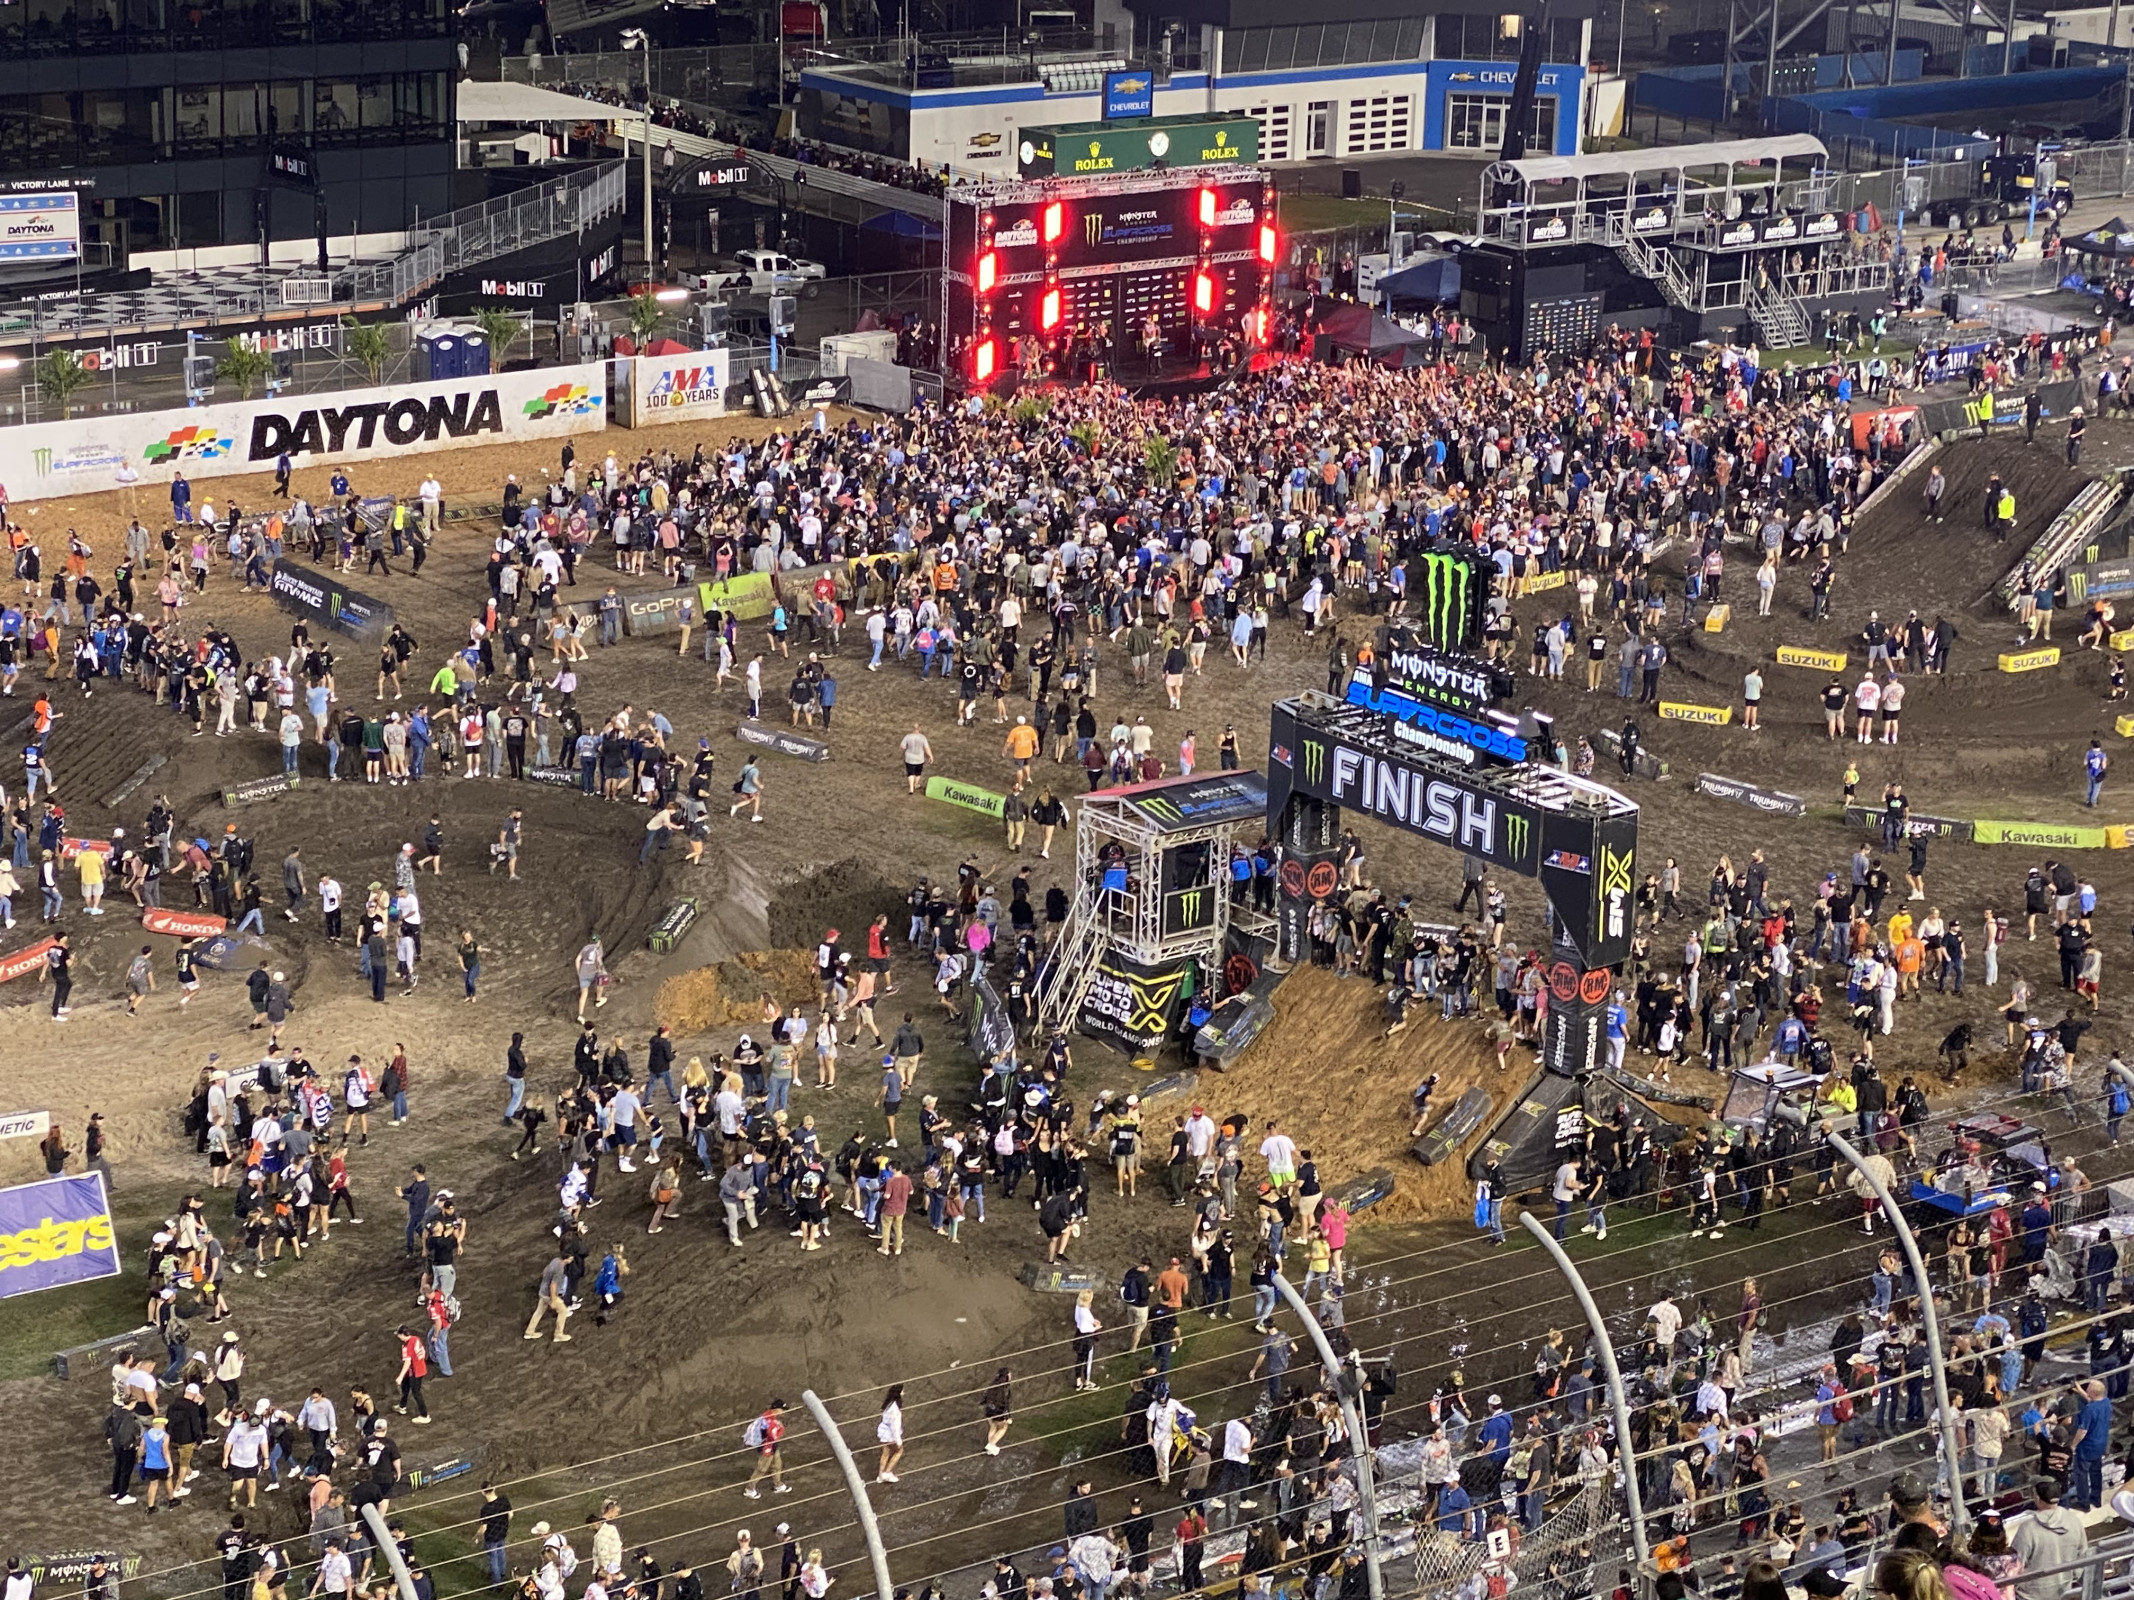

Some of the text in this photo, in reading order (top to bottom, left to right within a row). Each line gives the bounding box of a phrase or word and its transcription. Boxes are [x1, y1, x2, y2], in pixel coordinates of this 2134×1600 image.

[1480, 71, 1558, 85] CHEVET
[1109, 101, 1150, 113] CHEVROLET
[967, 151, 1002, 159] CHEVROLET
[1037, 150, 1053, 158] ROLEX
[1202, 147, 1238, 160] ROLEX
[275, 155, 298, 174] Mobil
[1075, 158, 1114, 171] ROLEX
[11, 181, 46, 190] VICTORY
[48, 180, 70, 188] LANE
[698, 168, 734, 186] Mobil
[1119, 211, 1158, 221] MONSTER
[8, 225, 54, 234] DAYTONA
[995, 229, 1037, 241] DAYTONA
[39, 292, 65, 300] VICTORY
[482, 280, 525, 296] Mobil
[651, 366, 716, 394] AMA
[646, 394, 668, 408] 100
[684, 388, 720, 402] YEARS
[249, 390, 504, 461] DAYTONA
[1781, 653, 1837, 668] SUZUKI
[2013, 654, 2056, 668] SUZUKI
[1353, 669, 1374, 688] AMA
[1391, 650, 1488, 702] MONSTER
[1404, 680, 1472, 710] ENERGY
[1346, 682, 1528, 762] SUPERCROSS
[1664, 706, 1722, 723] SUZUKI
[740, 728, 768, 742] TRIUMPH
[1394, 720, 1475, 766] Championship
[780, 738, 809, 754] TRIUMPH
[531, 769, 572, 783] MONSTER
[240, 783, 288, 800] MONSTER
[1700, 780, 1736, 797] TRIUMPH
[944, 786, 997, 812] Kawasaki
[1332, 744, 1496, 855] FINISH
[1749, 793, 1784, 810] TRIUMPH
[2001, 830, 2078, 845] Kawasaki
[1544, 849, 1590, 875] AMA
[170, 922, 222, 935] HONDA
[7, 951, 50, 977] HON
[1094, 971, 1133, 998] SUPER
[1088, 984, 1131, 1010] MOTO
[1084, 995, 1132, 1023] CROSS
[1085, 1014, 1114, 1032] WORLD
[1494, 1536, 1504, 1552] E
[50, 1561, 120, 1578] MONSR
